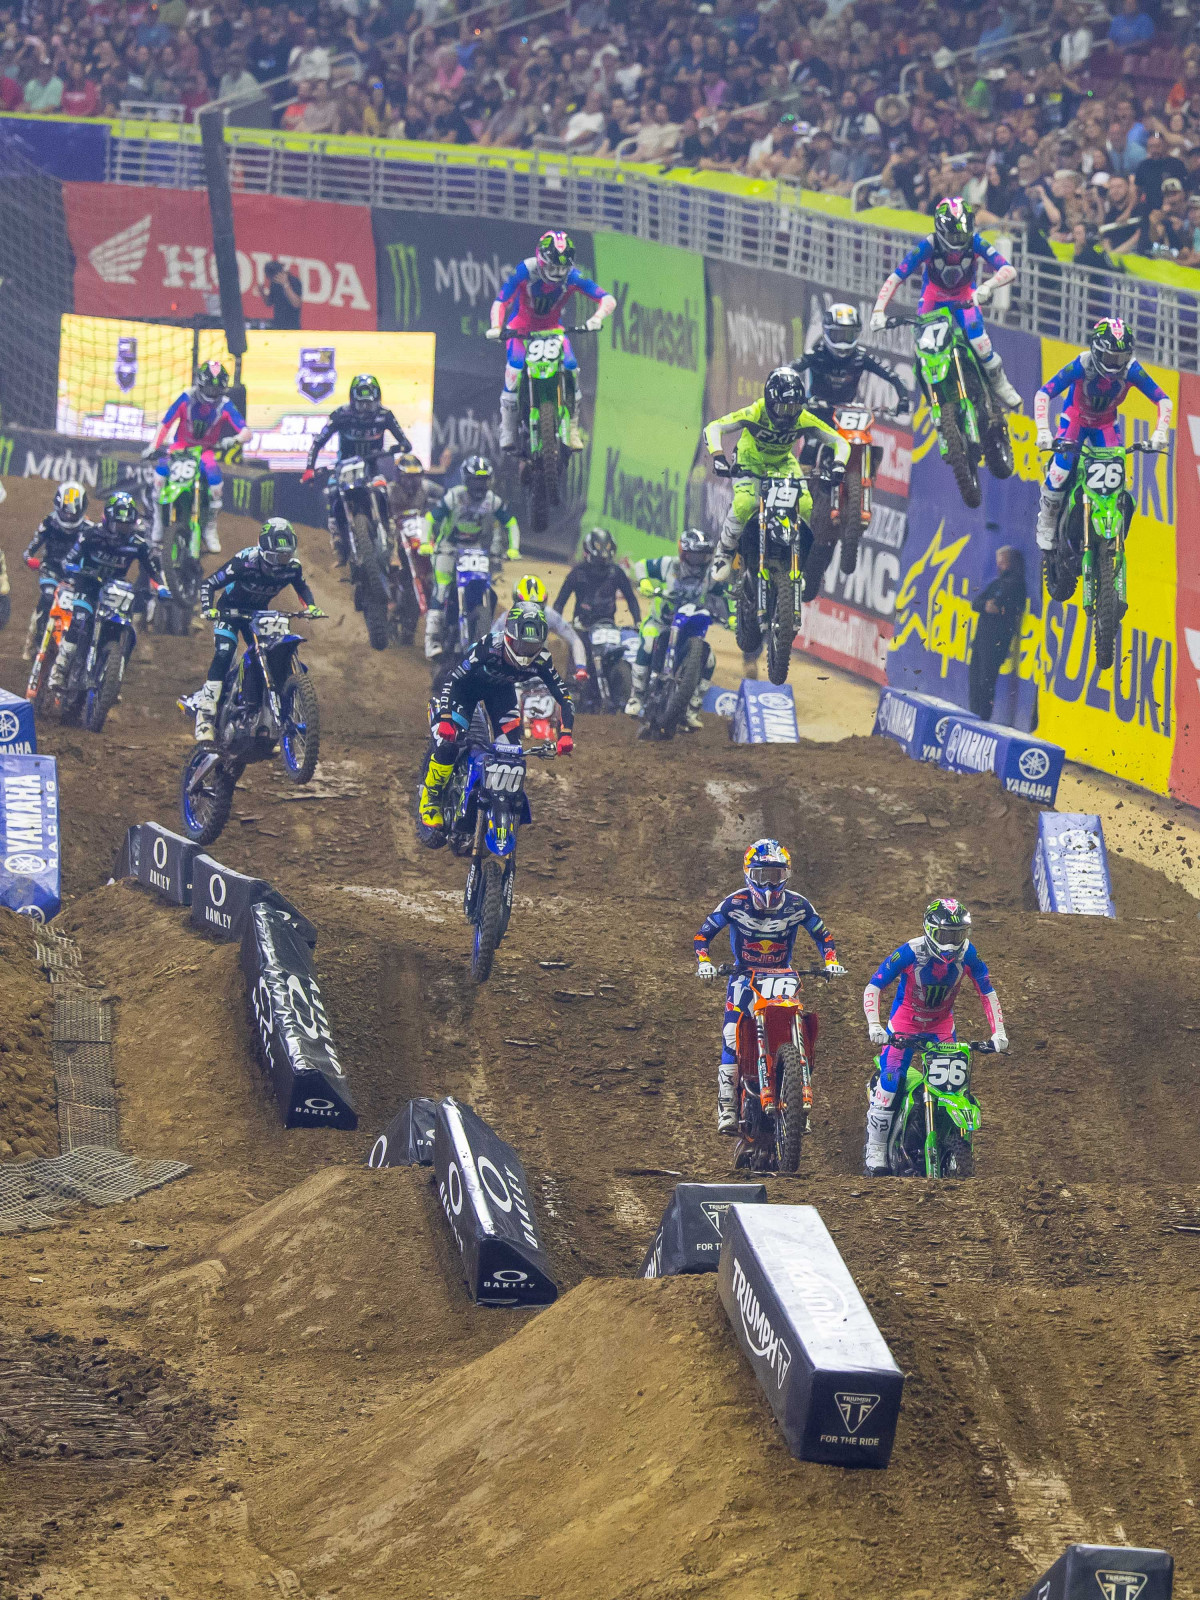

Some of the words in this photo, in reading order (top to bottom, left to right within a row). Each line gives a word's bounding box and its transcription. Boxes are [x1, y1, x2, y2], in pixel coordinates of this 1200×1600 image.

[528, 338, 562, 362] 98
[839, 411, 870, 431] 61
[169, 458, 197, 481] 36
[1087, 463, 1123, 489] 26
[766, 486, 799, 508] 19
[456, 555, 490, 573] 302
[956, 725, 998, 773] YAMAHA
[485, 763, 525, 793] 100
[1006, 777, 1052, 799] YAMAHA
[4, 774, 43, 853] YAMAHA
[46, 780, 59, 869] RACING
[757, 977, 798, 999] 16
[928, 1058, 967, 1086] 56
[295, 1107, 341, 1117] OAKLEY
[696, 1243, 714, 1251] FOR
[732, 1257, 779, 1369] TRIUMPH
[842, 1395, 872, 1403] TRIUMPH
[820, 1434, 839, 1443] FOR
[840, 1436, 858, 1445] THE
[859, 1437, 879, 1446] RIDE
[1105, 1573, 1138, 1585] TRIUMPH
